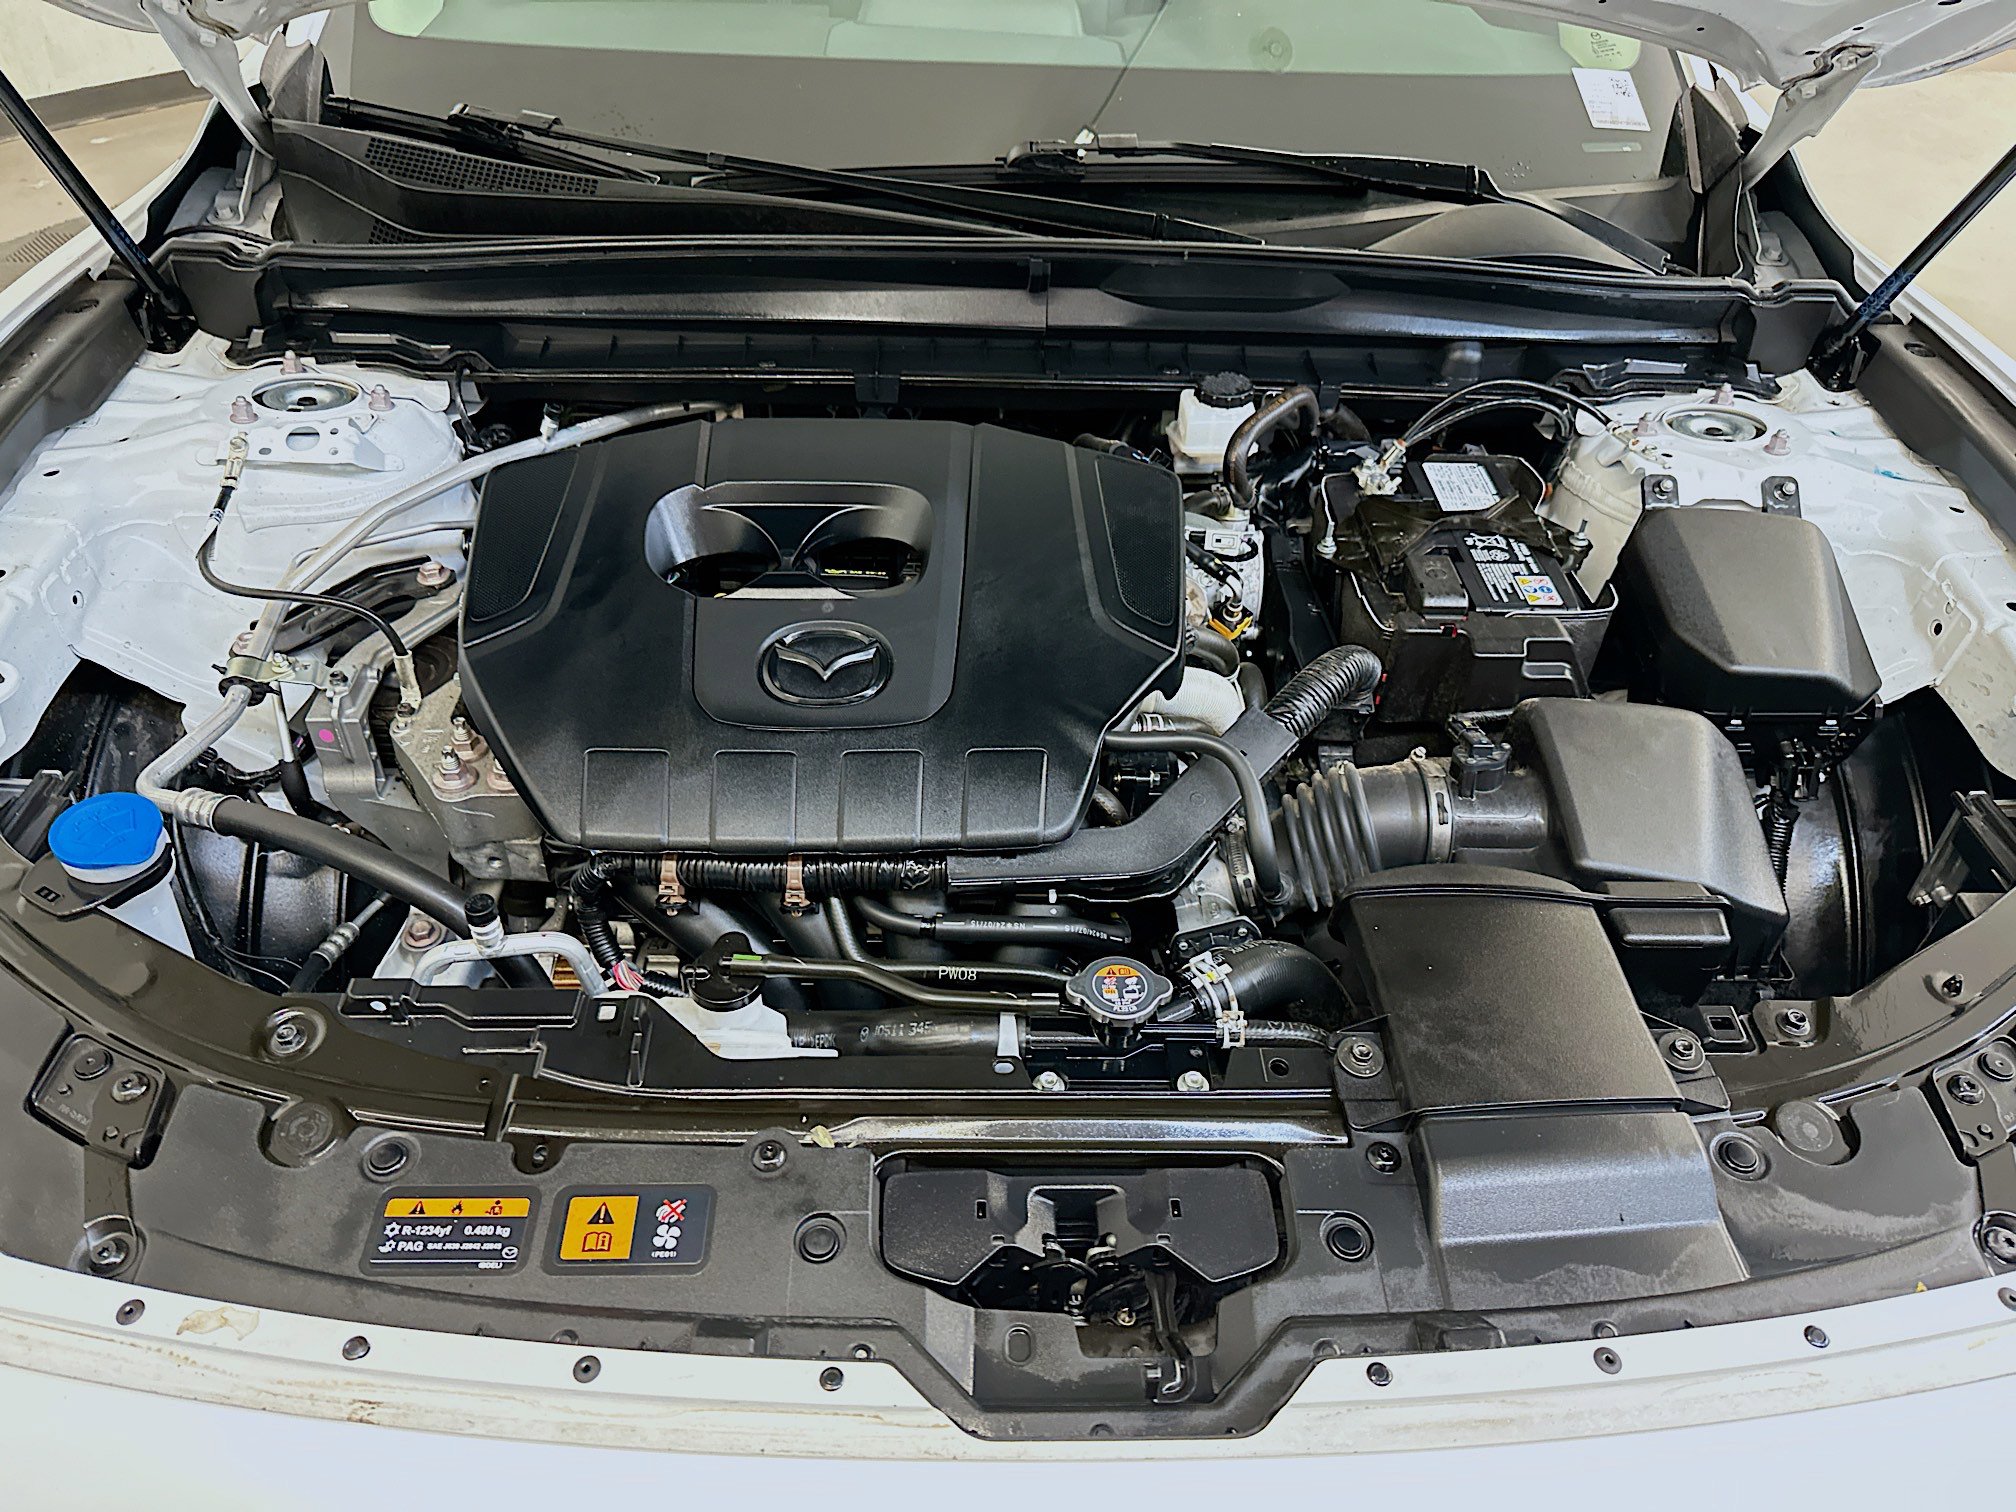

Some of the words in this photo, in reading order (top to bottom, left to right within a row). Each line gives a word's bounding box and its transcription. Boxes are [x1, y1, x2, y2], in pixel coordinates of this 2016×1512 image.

[938, 965, 977, 981] PW08
[401, 1224, 453, 1238] R-1234yf
[495, 1224, 511, 1238] kg
[396, 1240, 424, 1252] PAG
